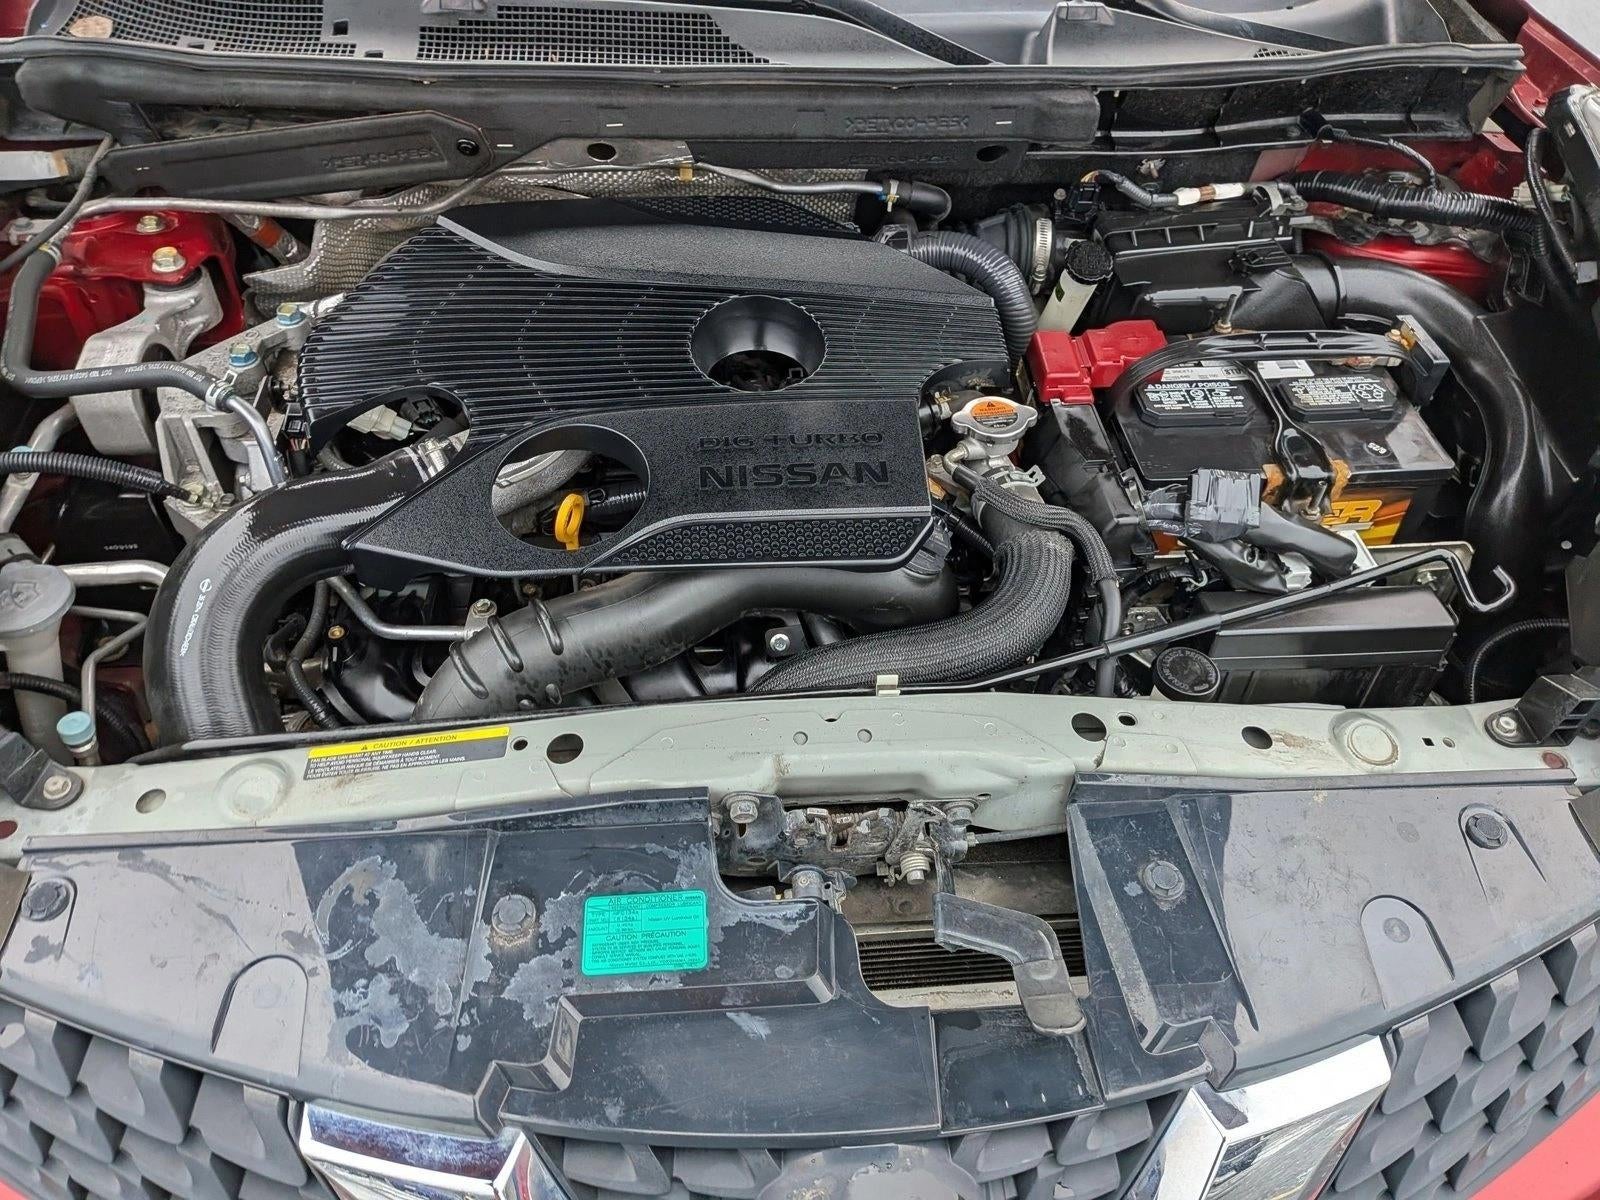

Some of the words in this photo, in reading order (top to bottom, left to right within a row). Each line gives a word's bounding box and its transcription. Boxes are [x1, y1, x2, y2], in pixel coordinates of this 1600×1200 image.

[700, 436, 754, 449] DIG
[763, 432, 883, 446] TURBO
[700, 460, 889, 489] NISSAN
[373, 739, 408, 749] CAUTION
[415, 734, 458, 745] ATTENTION
[607, 897, 621, 905] AIR
[626, 892, 683, 904] CONDITIONER
[605, 933, 637, 941] CAUTION
[641, 929, 686, 938] PRÉCAUTION
